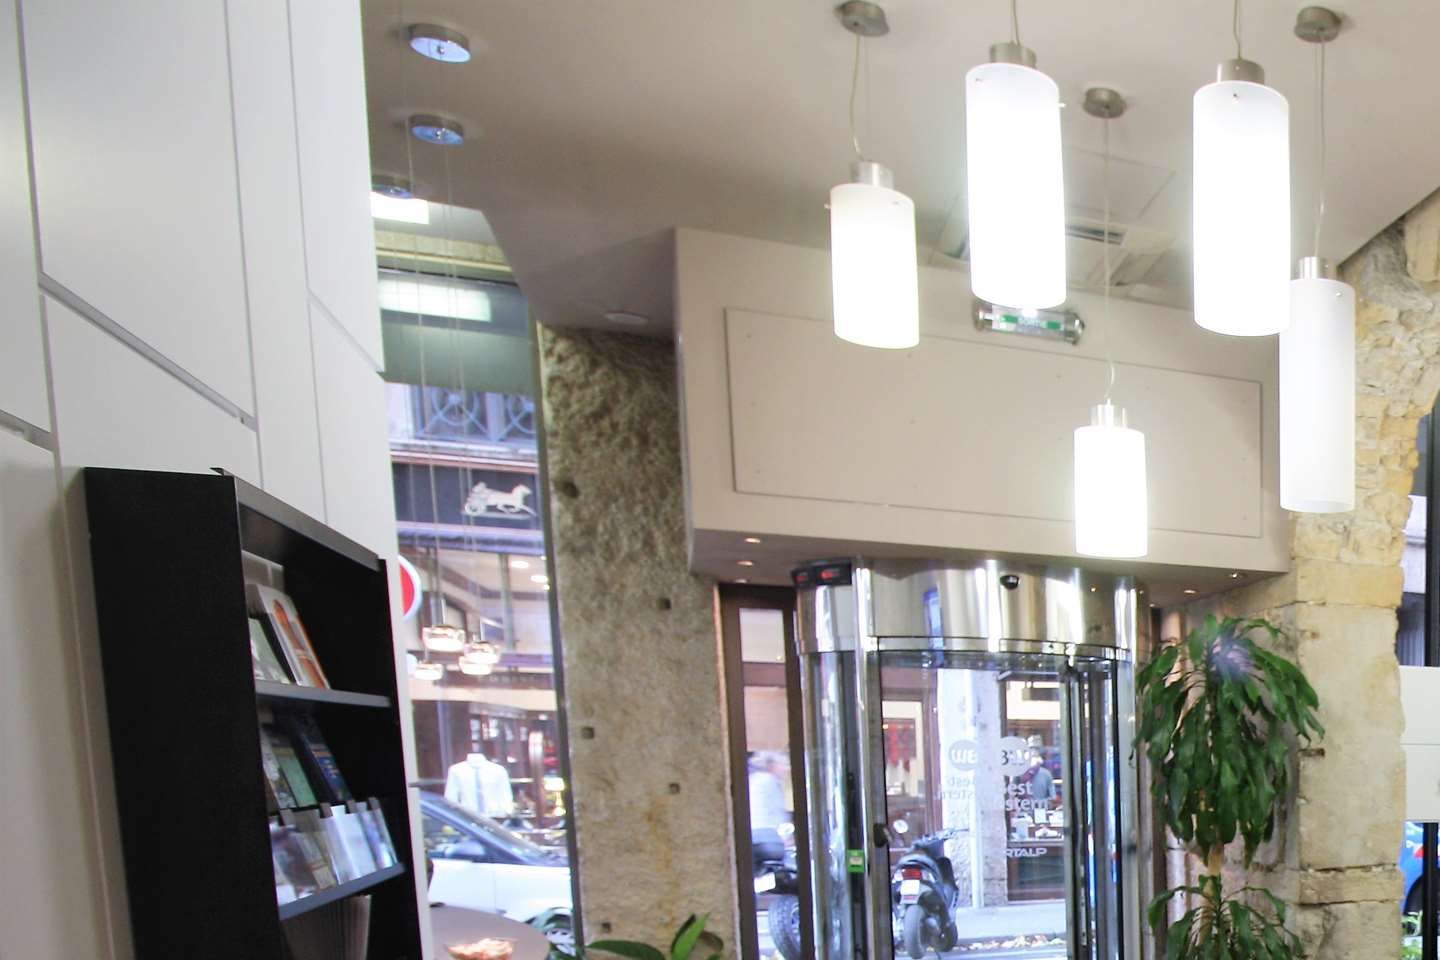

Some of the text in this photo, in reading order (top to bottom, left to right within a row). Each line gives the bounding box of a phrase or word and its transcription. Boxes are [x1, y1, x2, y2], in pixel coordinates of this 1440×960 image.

[1001, 780, 1033, 795] est
[995, 798, 1048, 811] stern
[1000, 847, 1048, 858] RTALP
